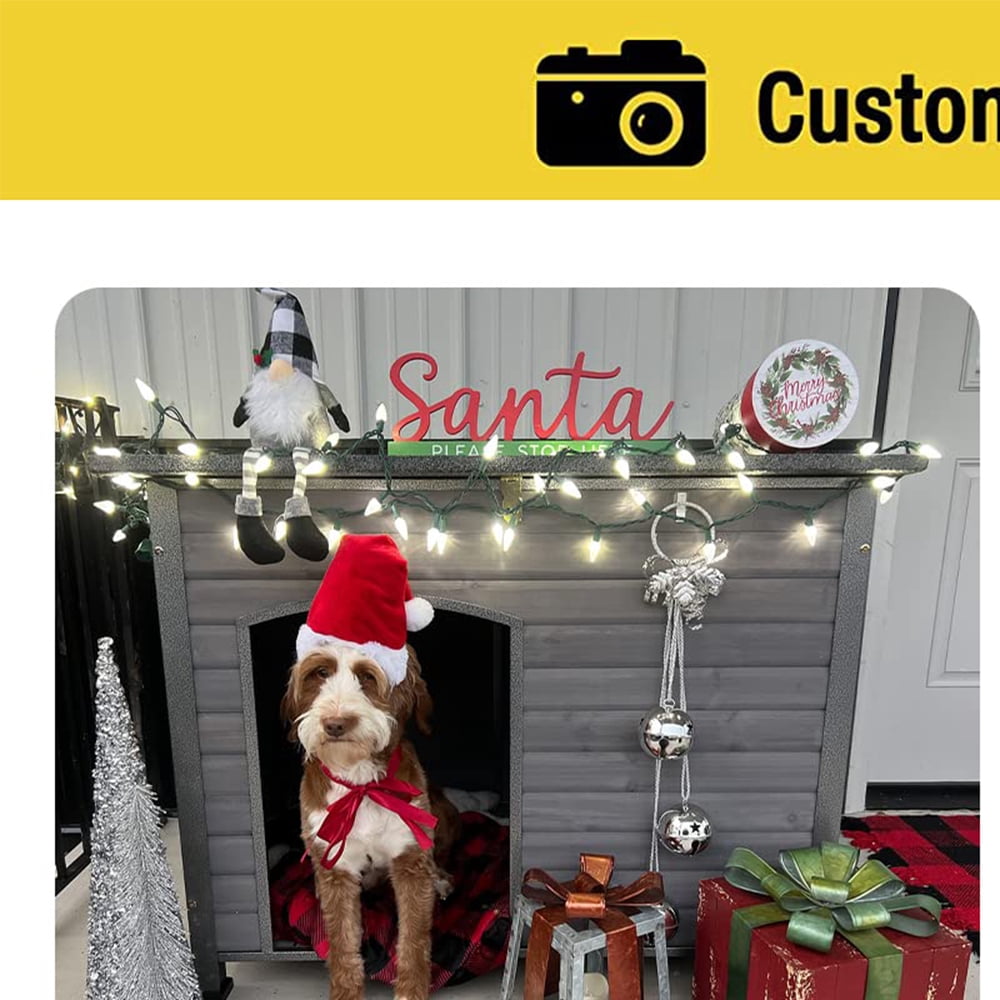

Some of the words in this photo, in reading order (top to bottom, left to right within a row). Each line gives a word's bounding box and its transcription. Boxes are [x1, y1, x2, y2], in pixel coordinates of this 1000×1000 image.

[389, 350, 675, 442] Santa
[783, 375, 825, 398] Merry
[768, 389, 842, 419] Christmas
[431, 444, 505, 456] PLEAE
